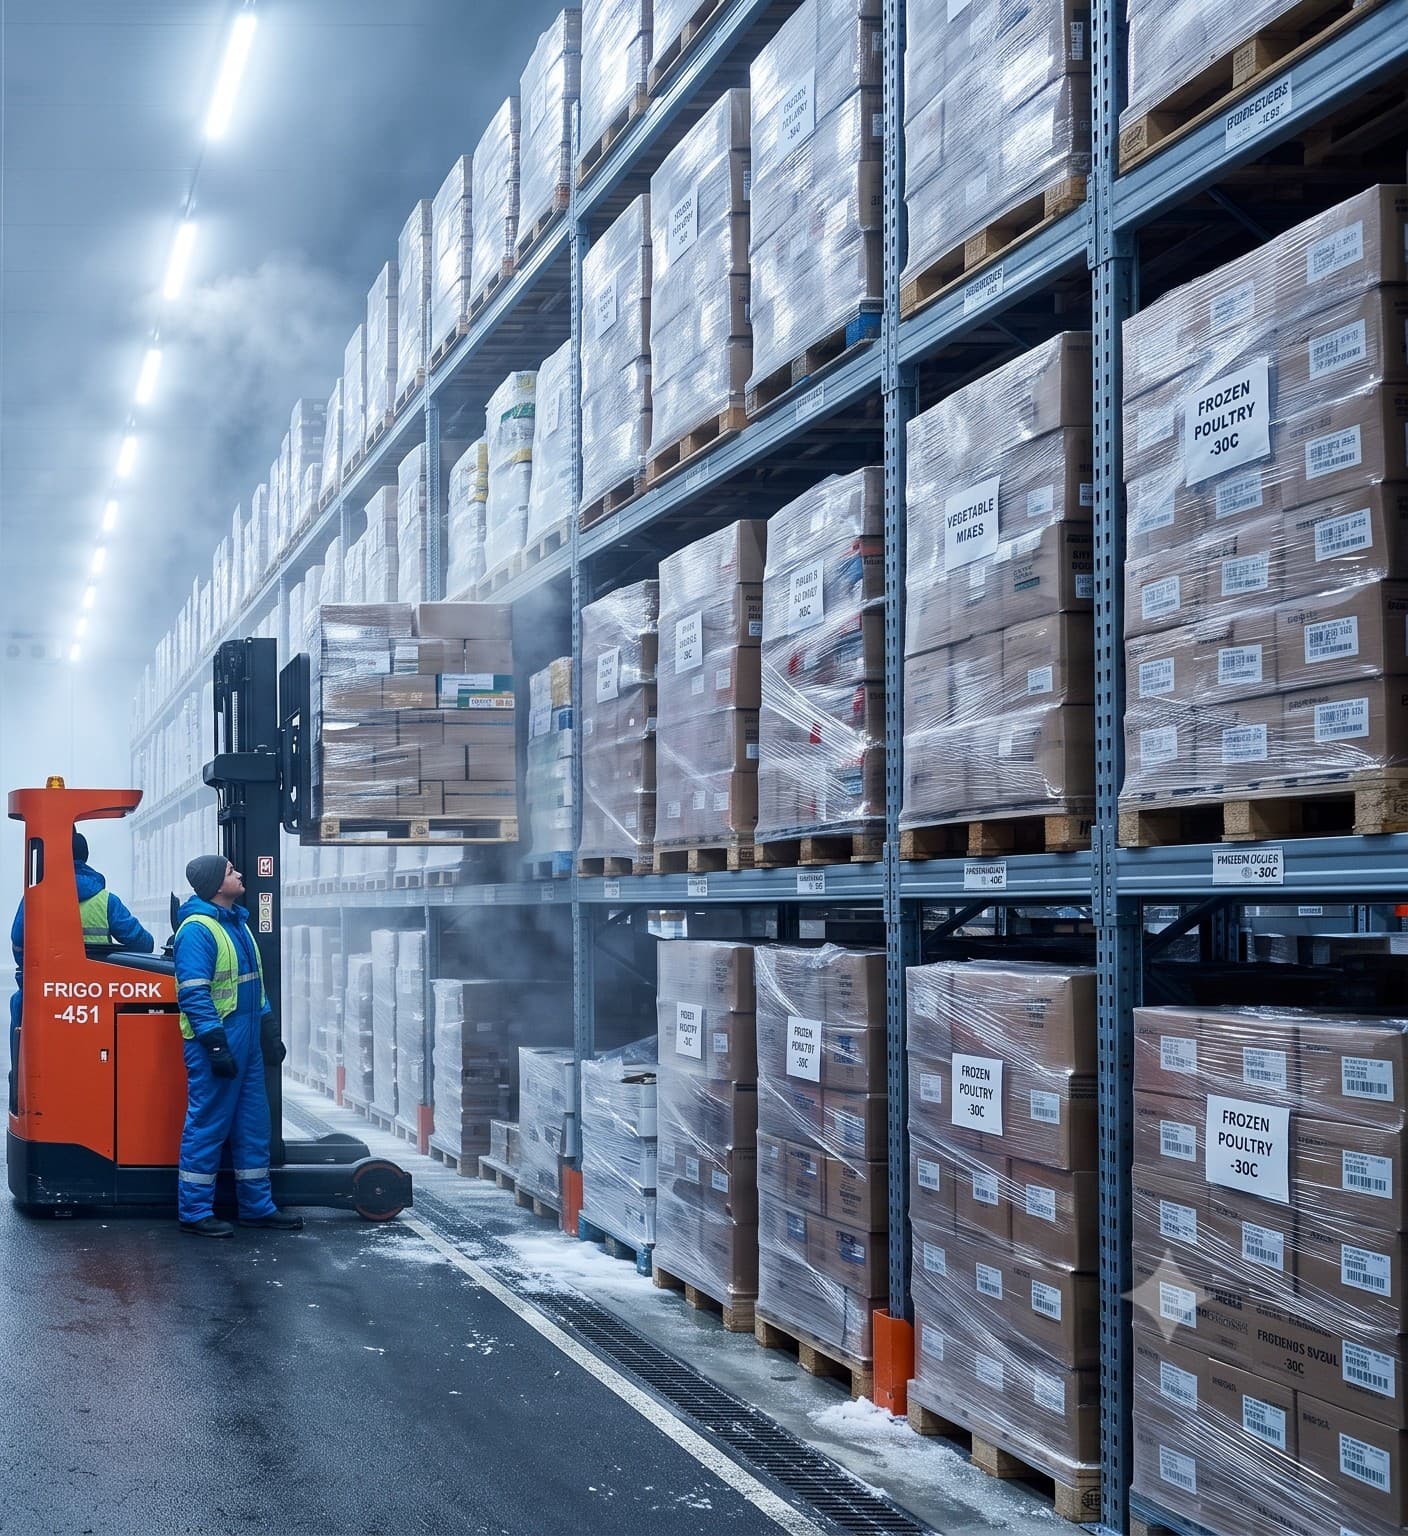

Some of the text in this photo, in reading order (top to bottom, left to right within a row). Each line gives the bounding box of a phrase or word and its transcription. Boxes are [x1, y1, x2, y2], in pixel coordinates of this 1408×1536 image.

[1198, 380, 1250, 416] FROZEN
[1194, 401, 1256, 441] POULTRY
[1210, 433, 1239, 455] -30C
[947, 498, 994, 529] VEGETABLE
[1253, 866, 1278, 878] -30C
[43, 982, 162, 998] FRIGO FORK
[54, 1005, 100, 1024] -451
[961, 1064, 991, 1081] FROZEN
[959, 1082, 993, 1101] POULTRY
[967, 1103, 985, 1118] -30C
[1222, 1110, 1270, 1132] FROZEN
[1218, 1131, 1273, 1157] POULTRY
[1230, 1159, 1259, 1178] -30C
